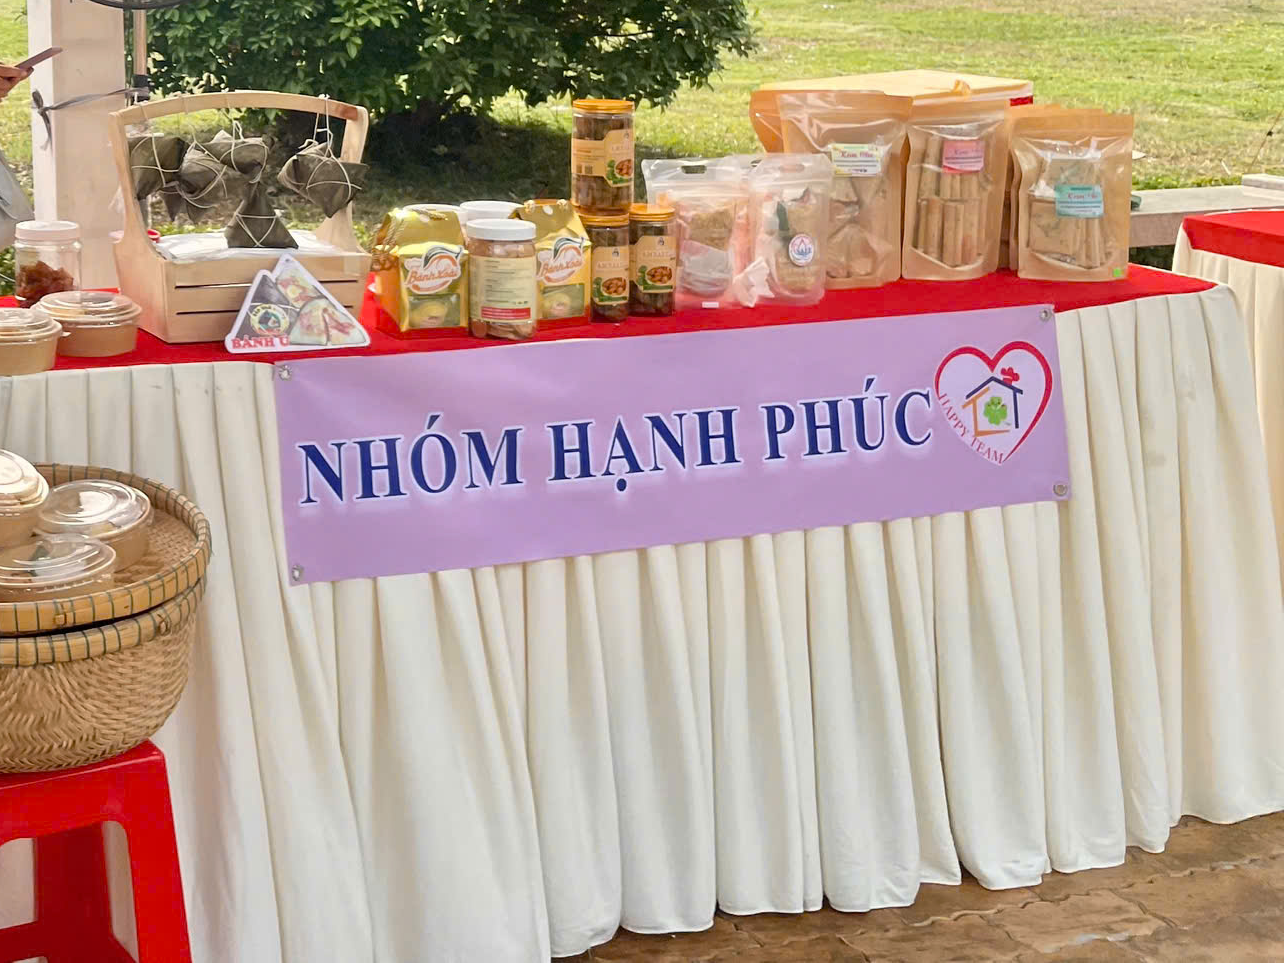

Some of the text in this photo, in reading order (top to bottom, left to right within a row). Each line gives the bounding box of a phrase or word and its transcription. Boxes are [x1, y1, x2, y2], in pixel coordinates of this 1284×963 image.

[298, 377, 932, 504] NHÓM HẠNH PHÚC
[938, 392, 1004, 464] HAPPY TEAM
